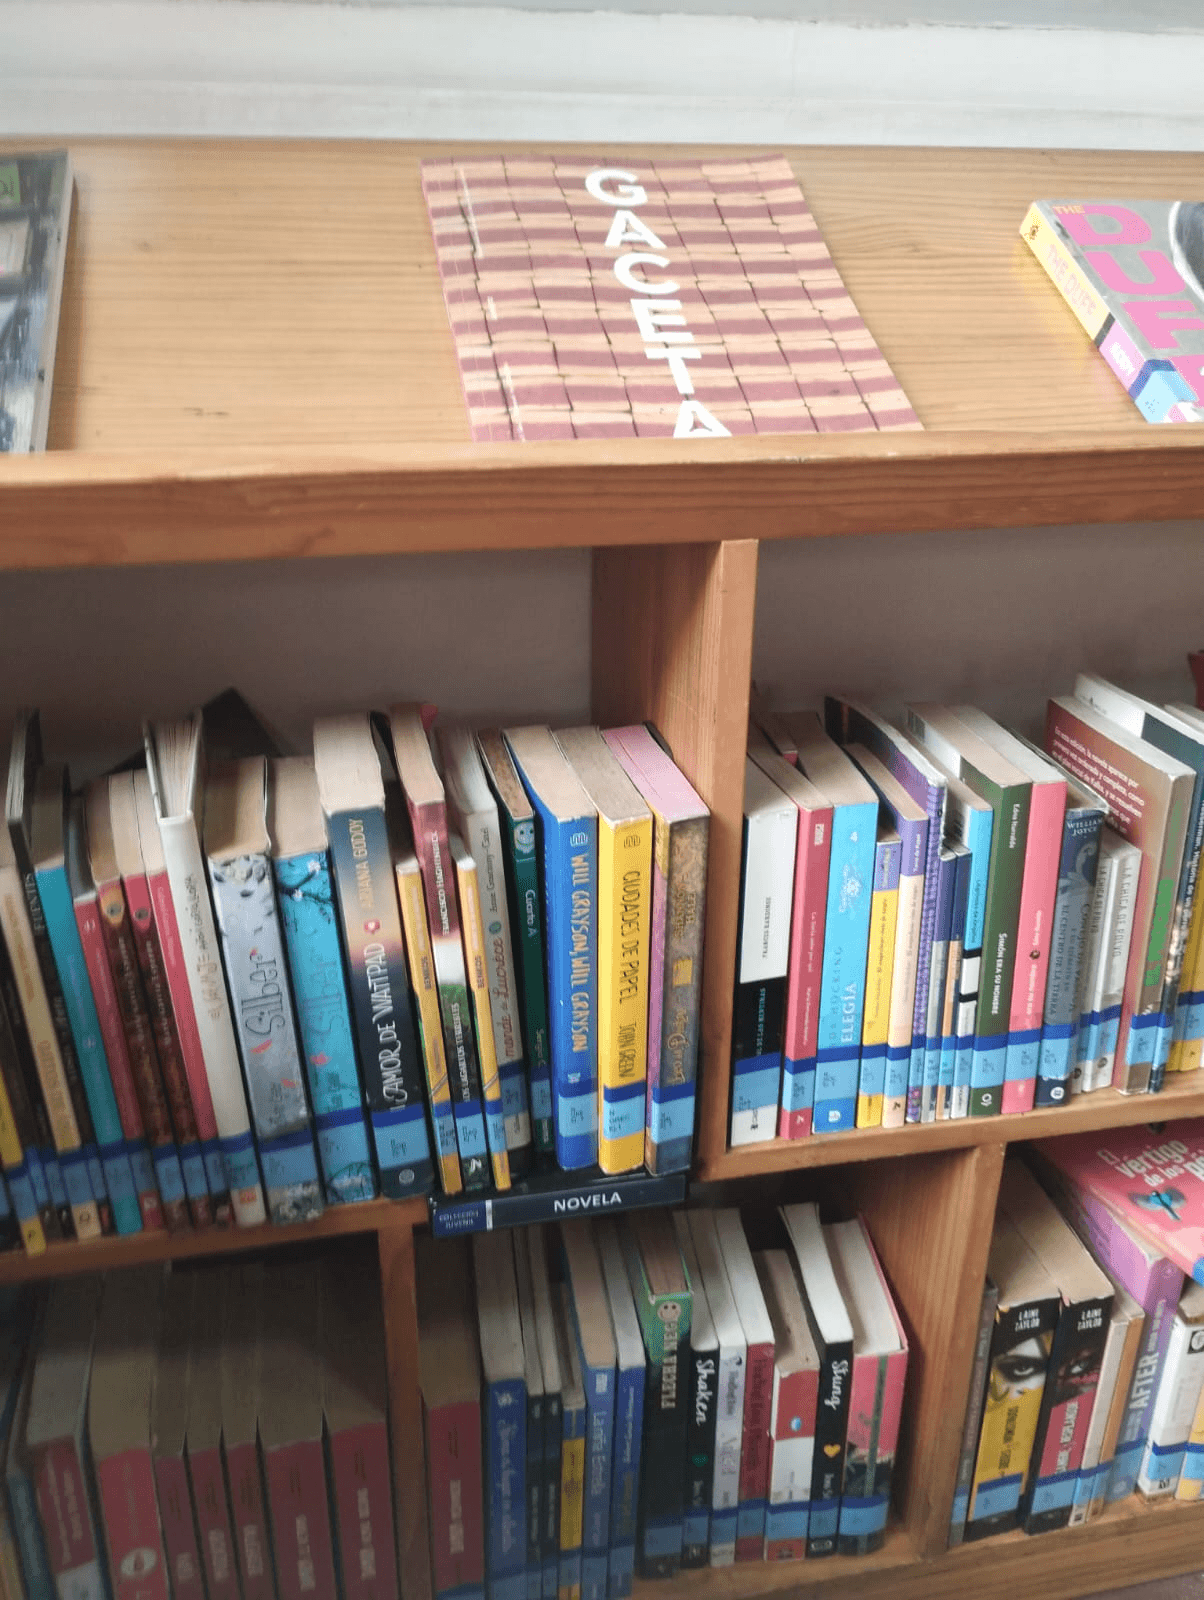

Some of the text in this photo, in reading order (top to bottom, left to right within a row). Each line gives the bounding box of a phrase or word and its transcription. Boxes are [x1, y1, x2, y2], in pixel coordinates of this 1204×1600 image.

[585, 168, 733, 439] GACETA
[349, 819, 368, 859] GODOY
[570, 853, 591, 888] WILL
[524, 889, 538, 937] Cuarto A
[1112, 866, 1133, 958] LA CHICA DE POLVO
[618, 870, 642, 1005] CIUDADES DE PAPEL
[997, 932, 1008, 957] SIMÓN
[1056, 916, 1069, 955] CENTRO
[570, 956, 591, 989] WILL
[995, 958, 1004, 973] ERA
[1053, 969, 1063, 981] LA
[1055, 955, 1064, 968] DE
[242, 953, 286, 1037] Silber
[363, 943, 394, 1024] WATTPAD
[991, 984, 1002, 1015] NOMBRE
[1049, 983, 1062, 1016] TIERRA
[376, 1020, 397, 1041] DE
[570, 991, 590, 1053] GRAYSON
[840, 983, 858, 1044] ELEGÍA
[618, 1021, 638, 1079] JOHN GREEN
[377, 1039, 408, 1103] AMOR
[1096, 1148, 1121, 1166] El
[1114, 1139, 1188, 1179] vértigo
[1143, 1172, 1165, 1187] de
[1156, 1164, 1185, 1180] los
[553, 1191, 622, 1213] NOVELA
[695, 1358, 716, 1427] Shaken
[823, 1359, 850, 1411] Stung
[1130, 1352, 1160, 1409] AFTER
